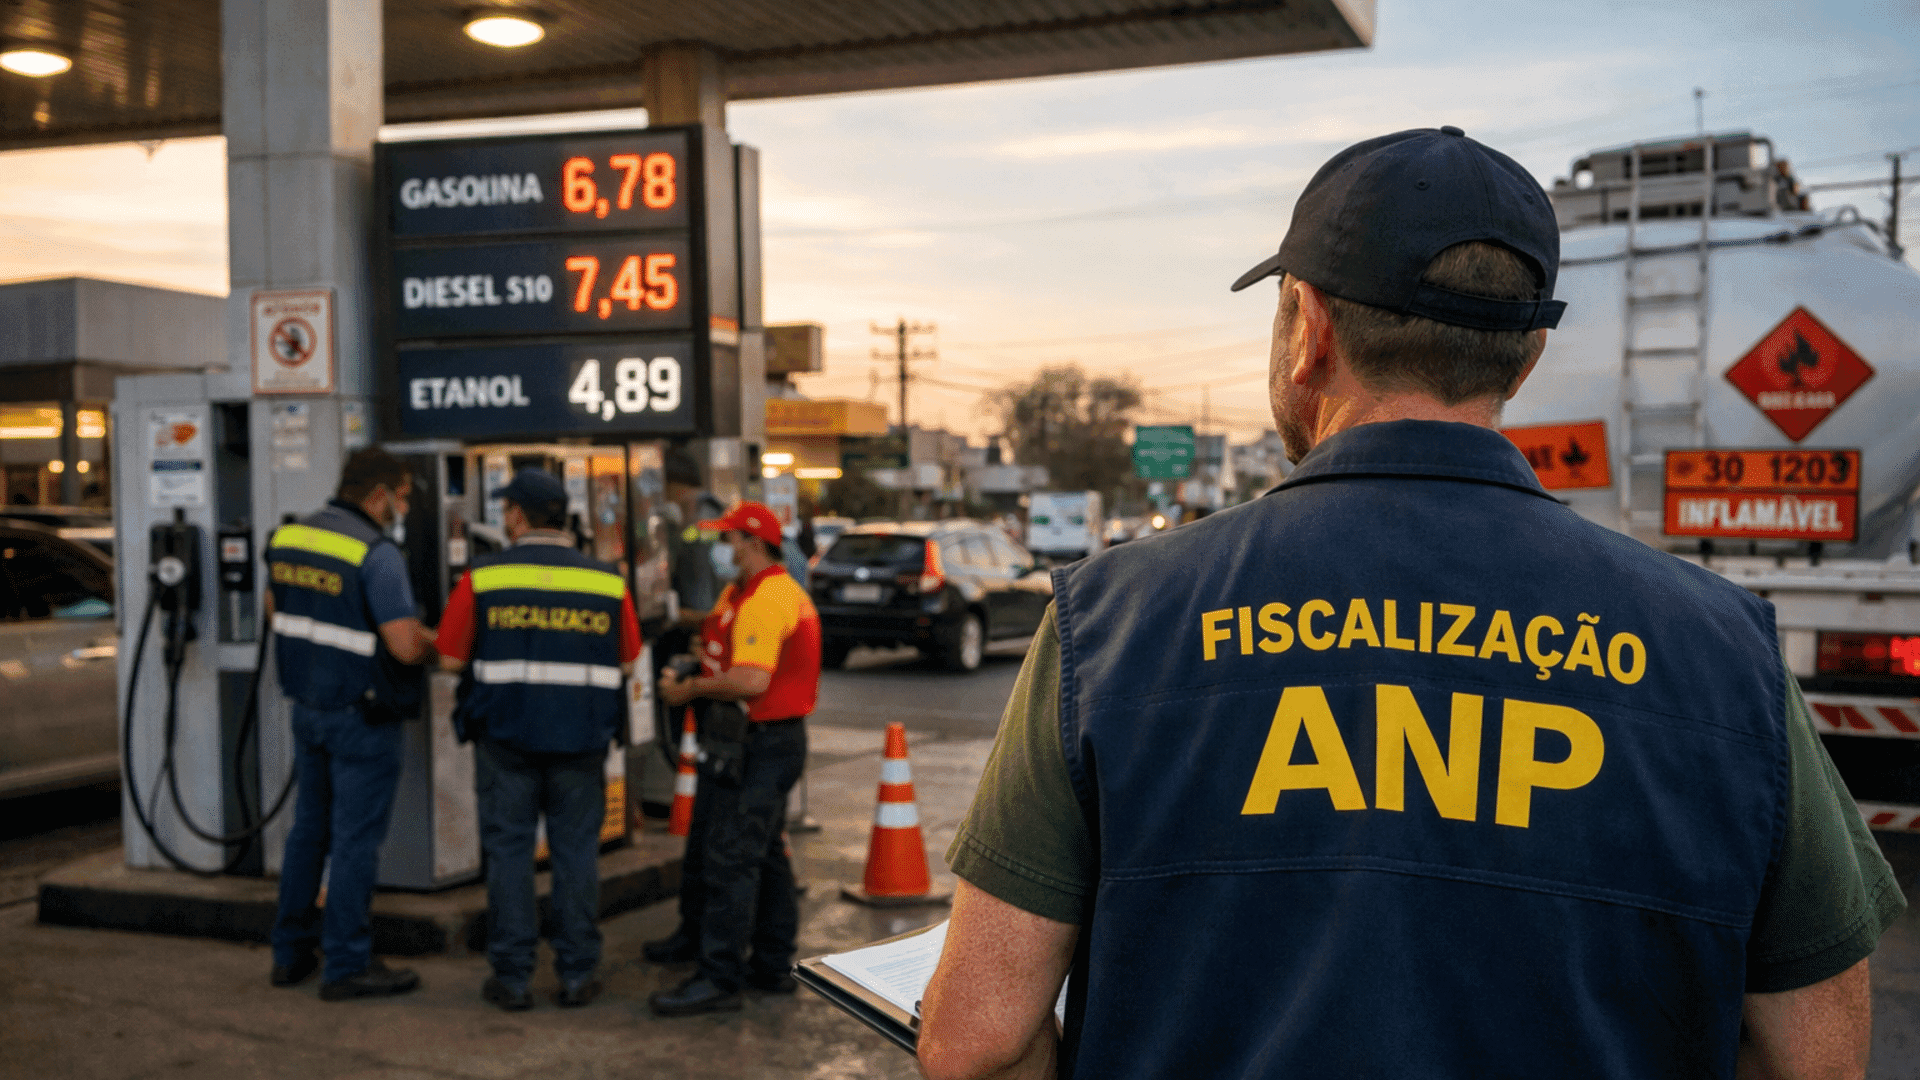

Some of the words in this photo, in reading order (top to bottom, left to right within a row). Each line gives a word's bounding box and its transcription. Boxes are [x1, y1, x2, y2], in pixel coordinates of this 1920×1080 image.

[562, 152, 677, 219] 6,78
[403, 275, 501, 309] DIESEL
[506, 275, 553, 304] S10
[565, 253, 679, 319] 7,45
[410, 374, 531, 409] ETANOL
[568, 357, 681, 421] 4,89
[1704, 452, 1744, 483] 30
[1769, 452, 1850, 484] 1203
[1201, 598, 1647, 685] FISCALIZAÇÃO
[1240, 683, 1605, 829] ANP
